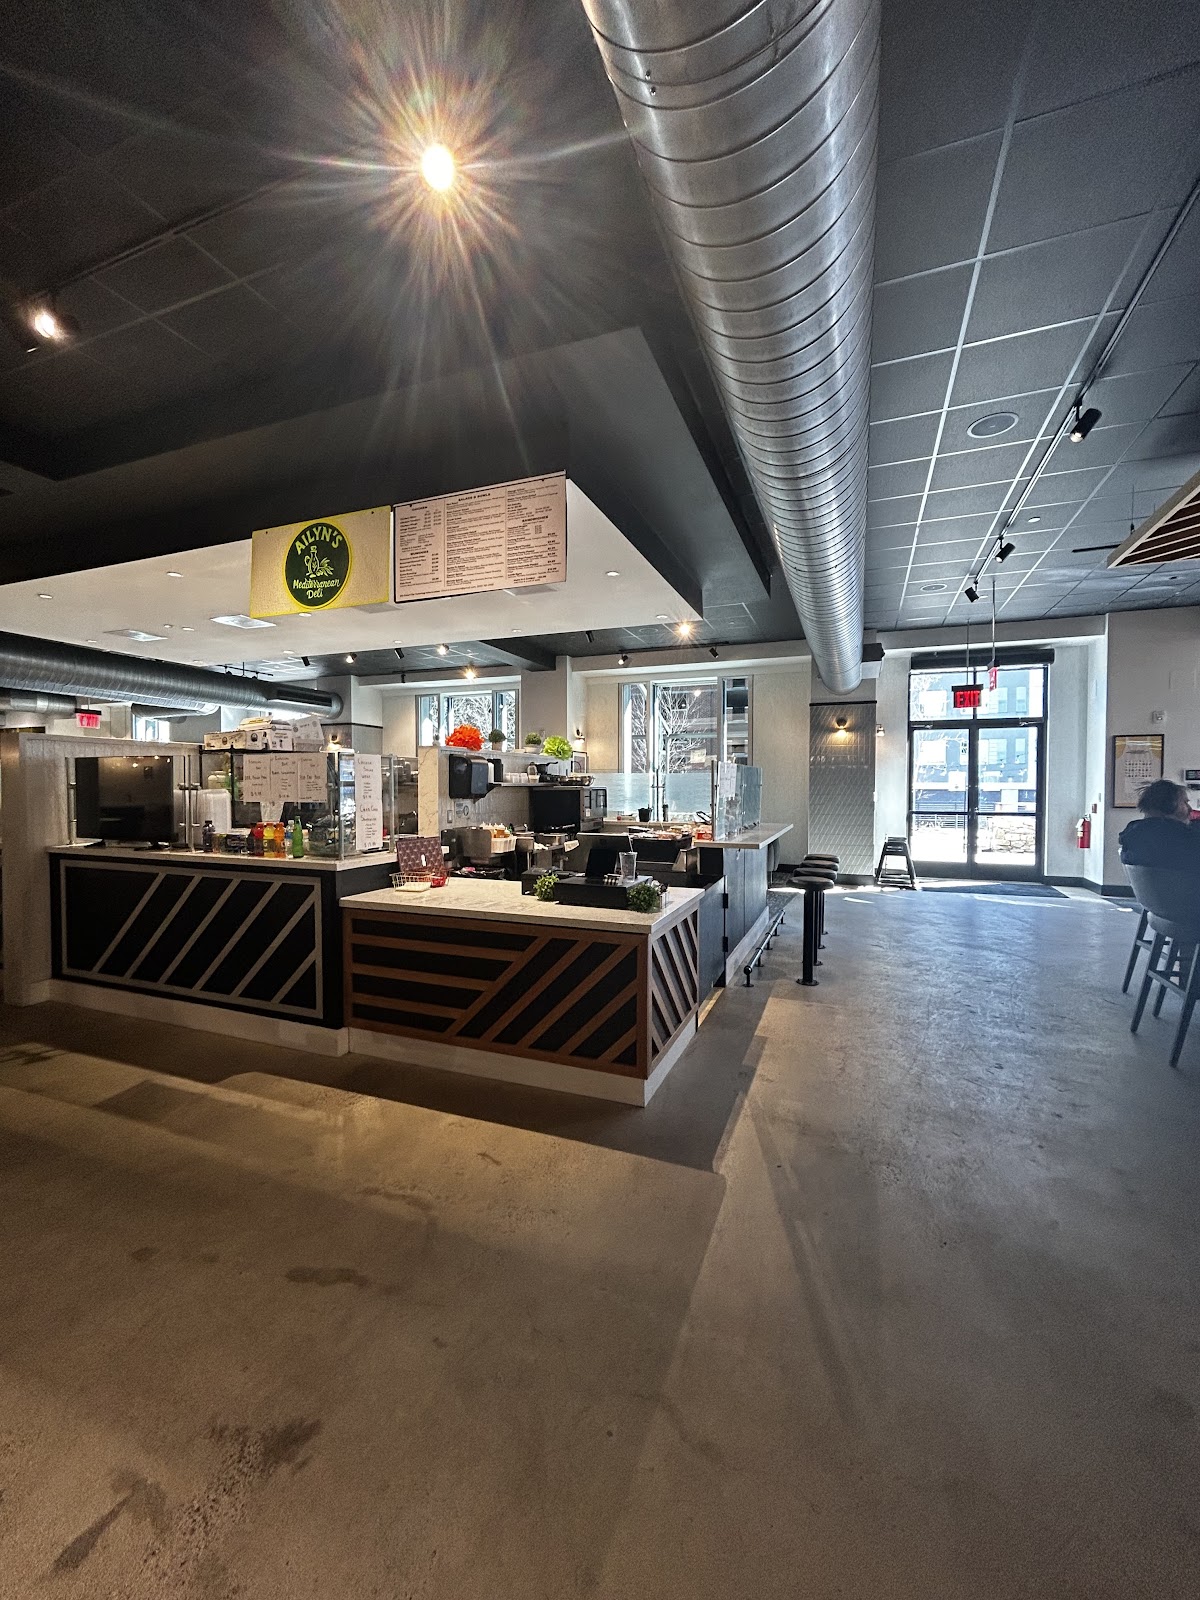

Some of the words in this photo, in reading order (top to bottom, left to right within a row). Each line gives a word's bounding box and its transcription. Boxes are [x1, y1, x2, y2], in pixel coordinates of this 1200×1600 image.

[295, 525, 343, 555] AILYN'S
[292, 577, 341, 590] Mediterranean
[306, 589, 324, 599] Deli
[956, 690, 980, 708] EXIT
[79, 715, 99, 727] EXIT
